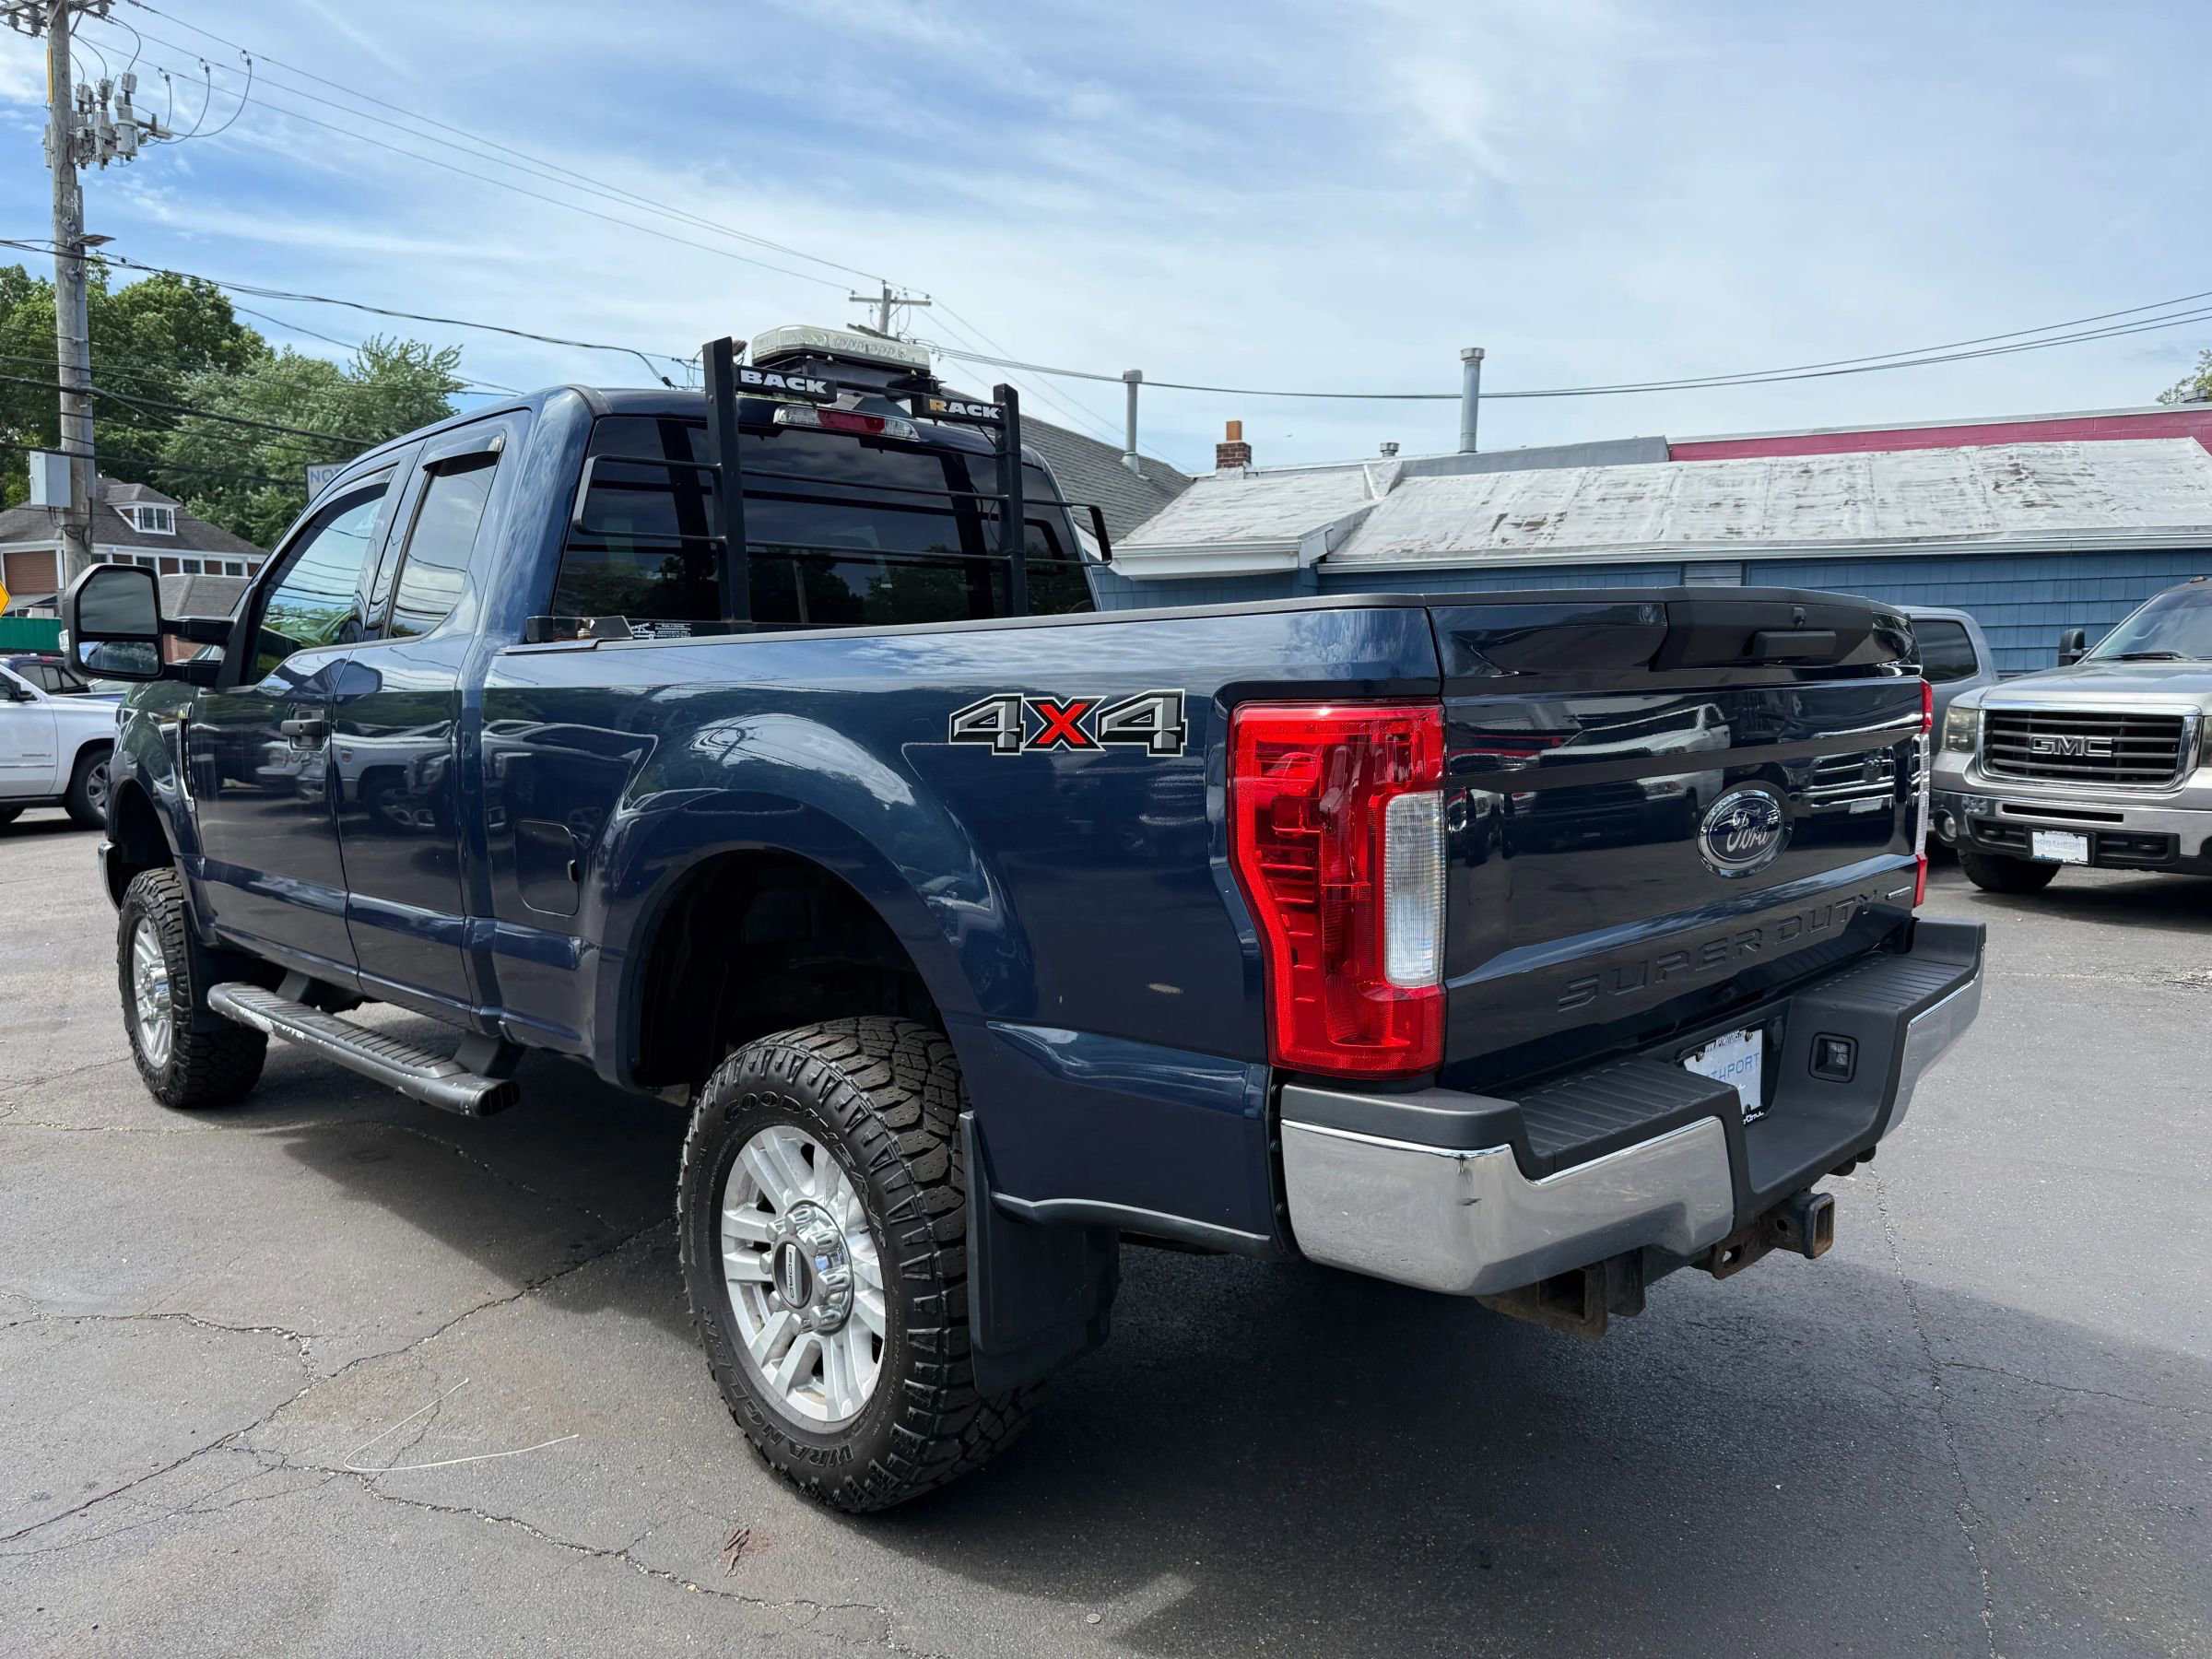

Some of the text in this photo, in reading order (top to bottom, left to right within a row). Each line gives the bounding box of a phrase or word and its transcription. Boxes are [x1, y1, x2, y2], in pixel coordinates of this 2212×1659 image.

[740, 370, 999, 419] BACK RACK
[310, 469, 341, 484] NO
[2030, 735, 2112, 758] GMC
[1716, 807, 1771, 853] Ford
[2034, 839, 2086, 849] NORTHPORT
[1558, 889, 1877, 1013] SUPER DUTY
[1706, 1053, 1760, 1081] THPORT
[724, 1090, 887, 1249] GOODYEAR
[700, 1306, 854, 1467] WRANGLER
